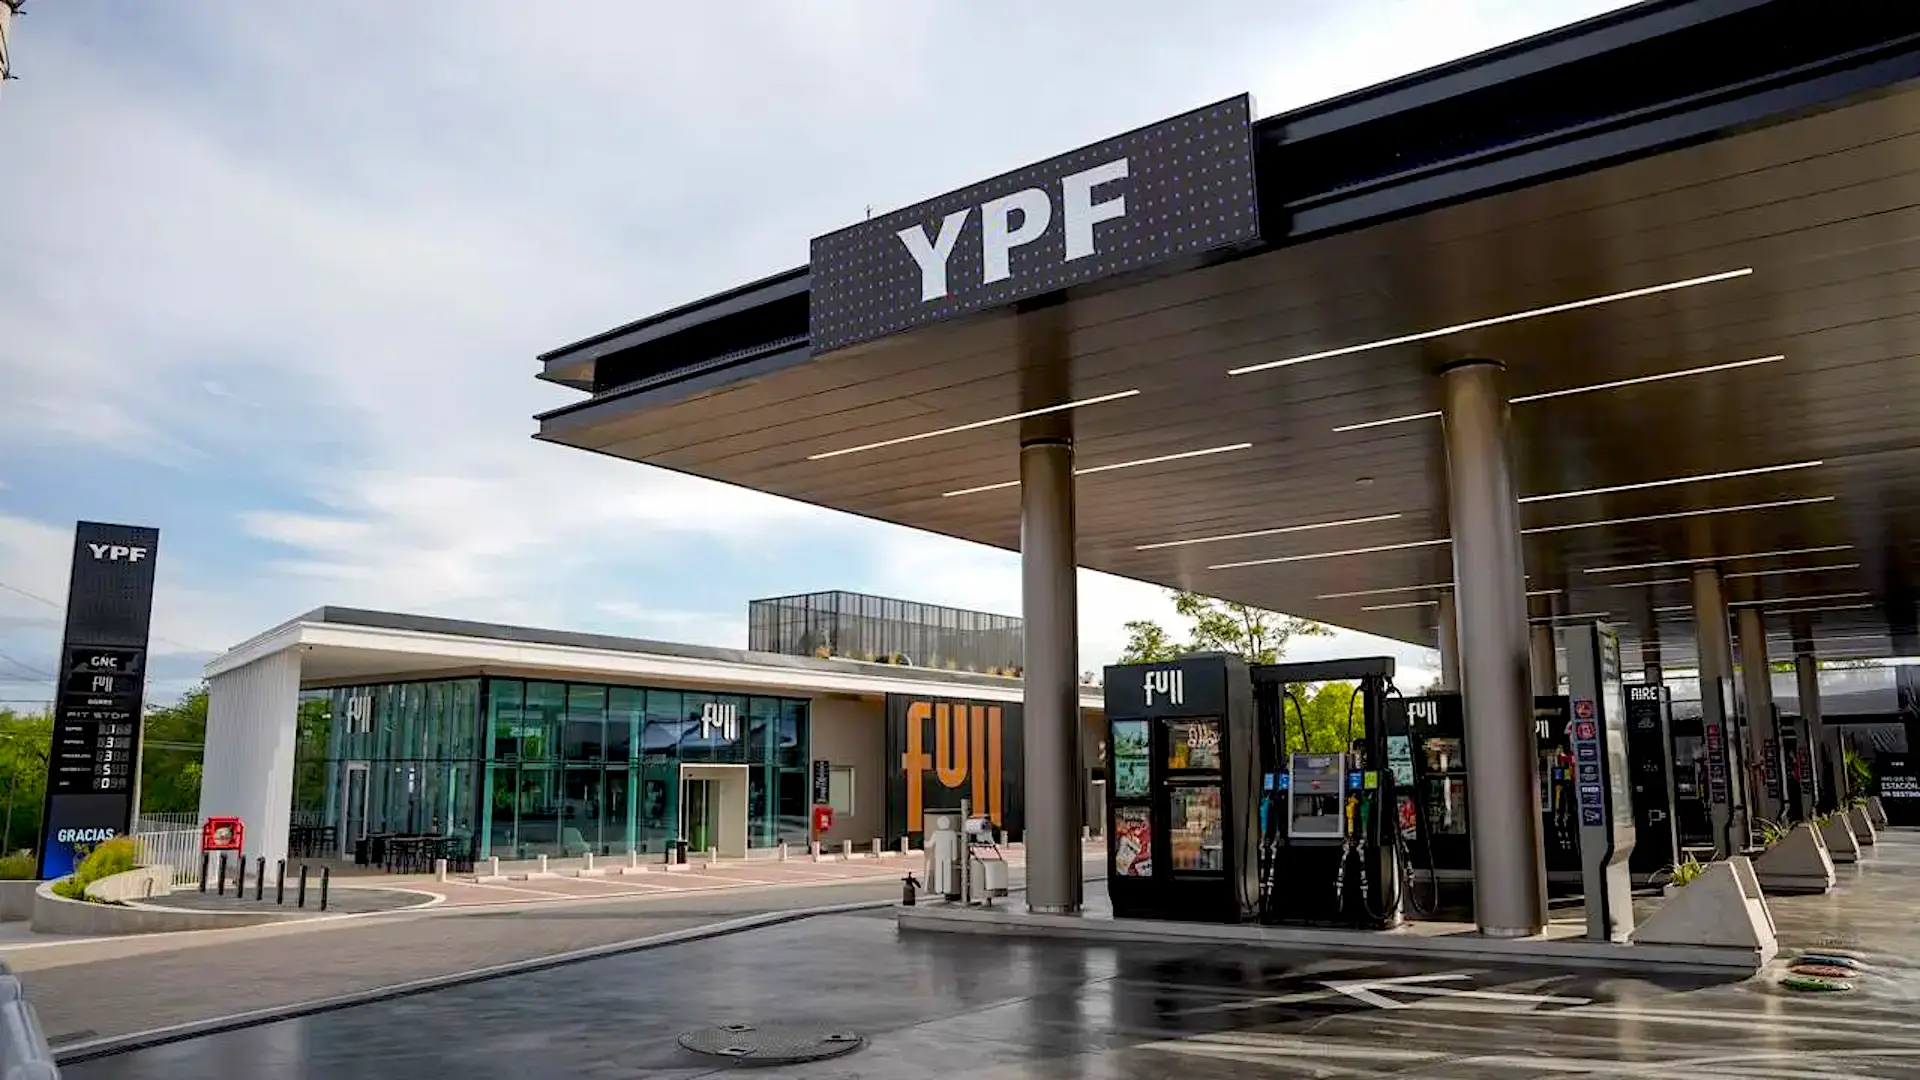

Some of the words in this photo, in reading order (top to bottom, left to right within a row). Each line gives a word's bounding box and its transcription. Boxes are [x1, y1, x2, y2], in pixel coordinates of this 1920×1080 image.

[896, 157, 1130, 303] YPF
[88, 543, 147, 562] YPF
[91, 655, 118, 667] GNC
[1144, 669, 1184, 706] full
[1631, 687, 1658, 701] AIRE
[346, 695, 373, 734] full
[701, 702, 738, 741] full
[1407, 701, 1438, 726] full
[901, 701, 1003, 832] full
[57, 828, 115, 843] GRACIAS
